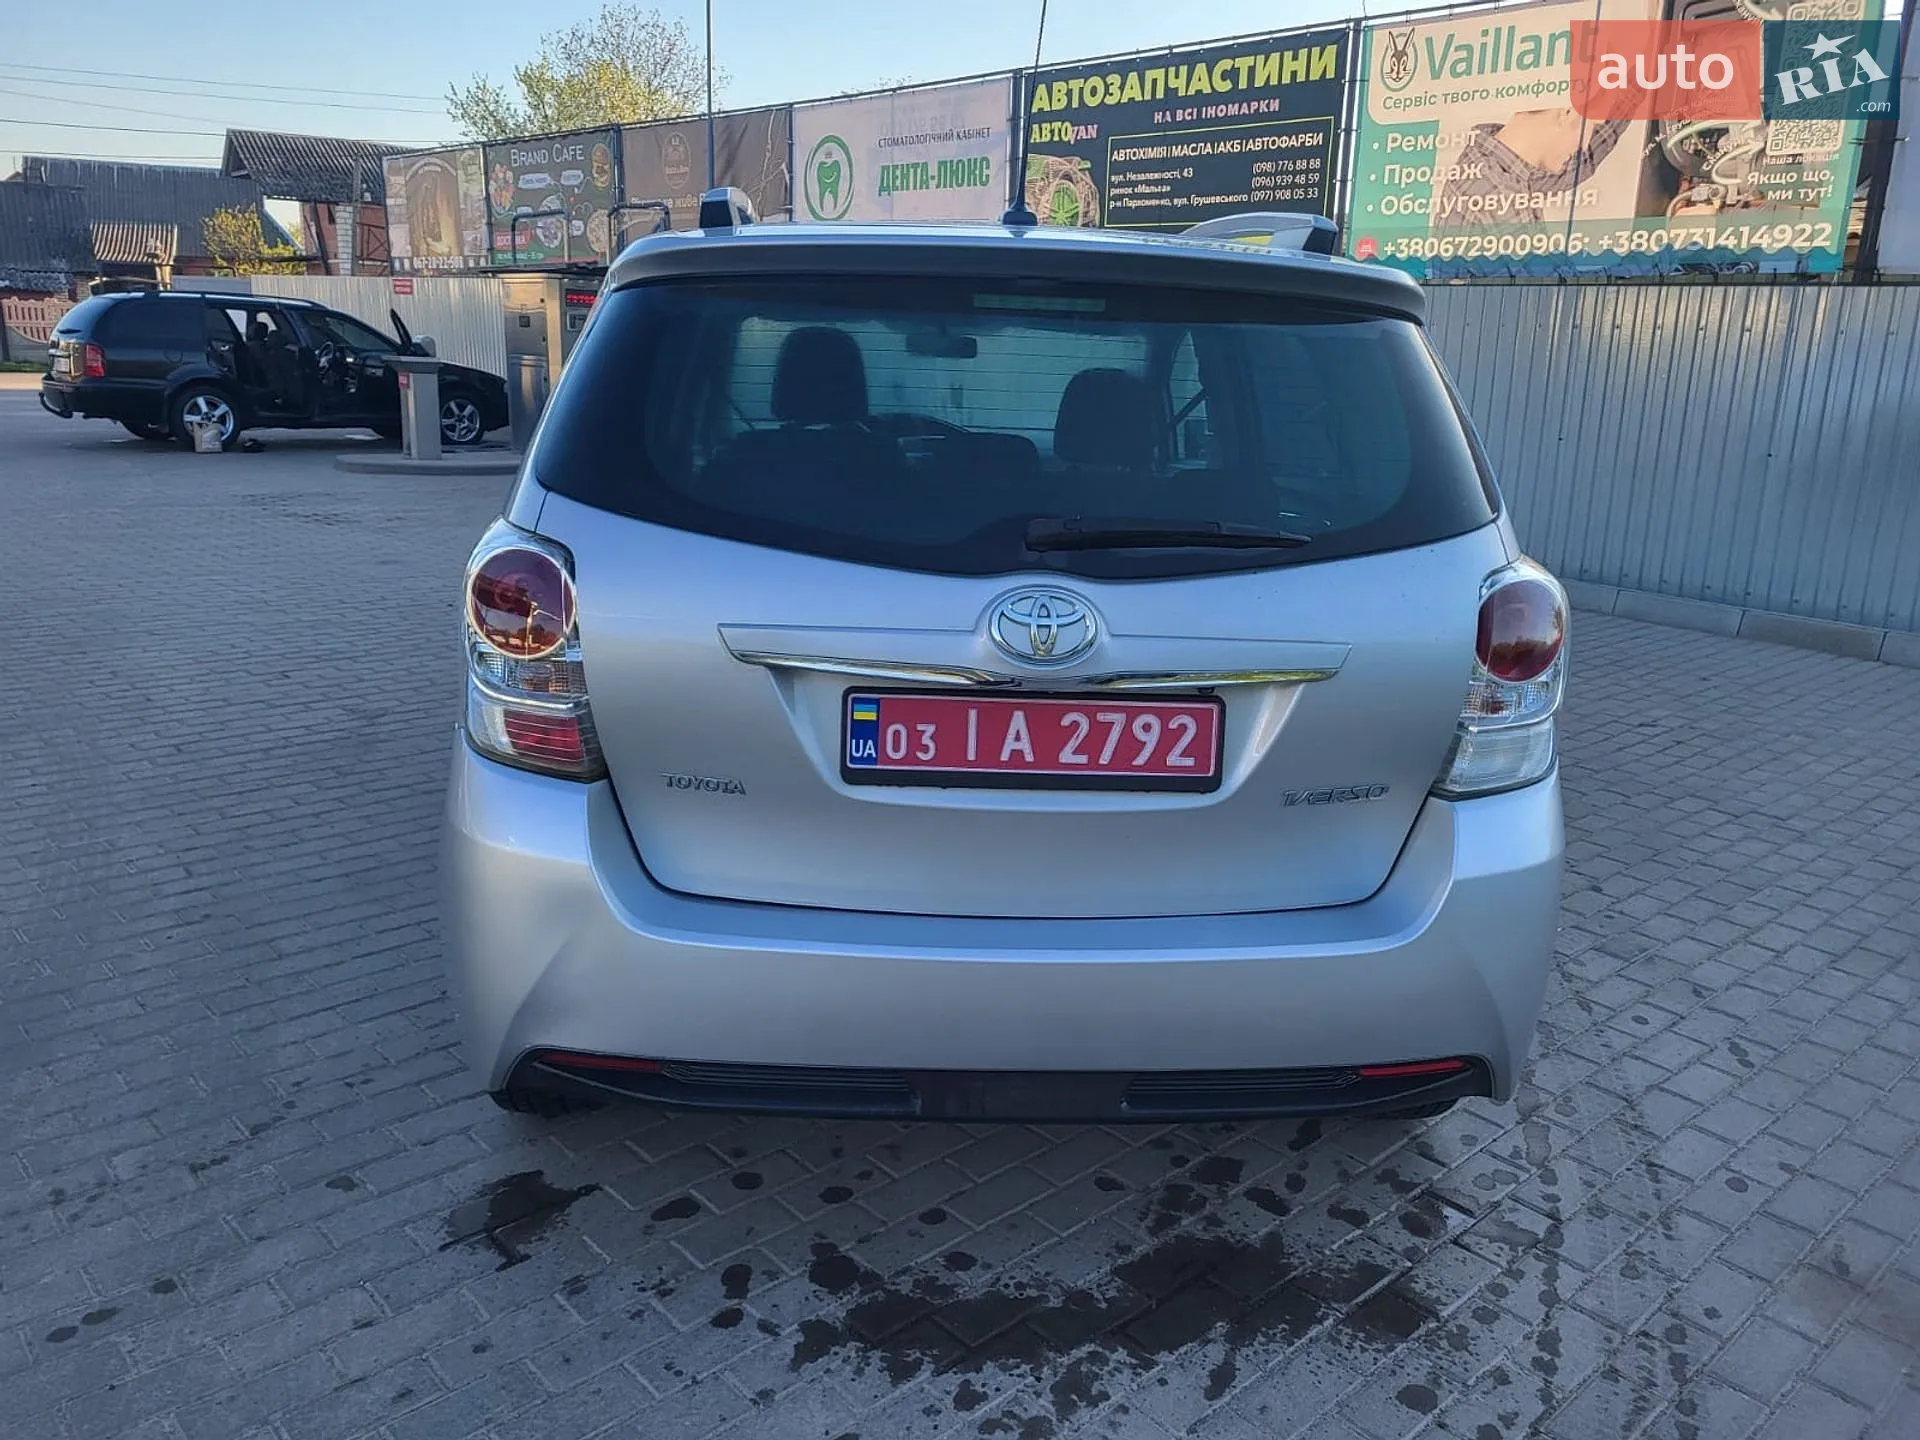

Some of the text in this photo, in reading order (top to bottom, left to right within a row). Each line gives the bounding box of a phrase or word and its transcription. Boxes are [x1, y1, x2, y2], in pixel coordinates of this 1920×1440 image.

[1031, 44, 1338, 113] АВТОЗАПЧАСТИНИ
[1154, 98, 1280, 123] НА ВСІ ІНОМАРКИ
[1383, 91, 1437, 112] Сервіс
[1442, 89, 1490, 105] твого
[878, 127, 991, 149] СТОМАТОЛОГІЧНИЙ КАБІНЕТ
[1112, 132, 1324, 161] АВТОХІМІЯ МАСЛА АКБ АВТОФАРБИ
[1387, 130, 1480, 153] Ремонт
[510, 143, 585, 167] BRAND CAFE
[1252, 158, 1321, 175] (098) 776 88 88
[1762, 155, 1793, 165] Наша
[878, 156, 990, 197] ДЕНТА-ЛЮКС
[1182, 167, 1193, 178] 43
[1251, 172, 1320, 188] (096) 939 48 59
[1384, 161, 1483, 187] Продаж
[1747, 169, 1835, 185] Якщо що,
[1191, 193, 1248, 206] Грушевського
[1250, 187, 1319, 202] (097) 908 05 33
[1380, 186, 1599, 218] Обслуговування
[1767, 184, 1833, 202] ми тут!
[1598, 223, 1833, 253] +380731414922
[851, 739, 877, 759] UA
[885, 723, 937, 761] 03
[1058, 711, 1197, 767] 2792
[660, 772, 747, 796] TOYOTA
[1283, 784, 1390, 807] VERSO
